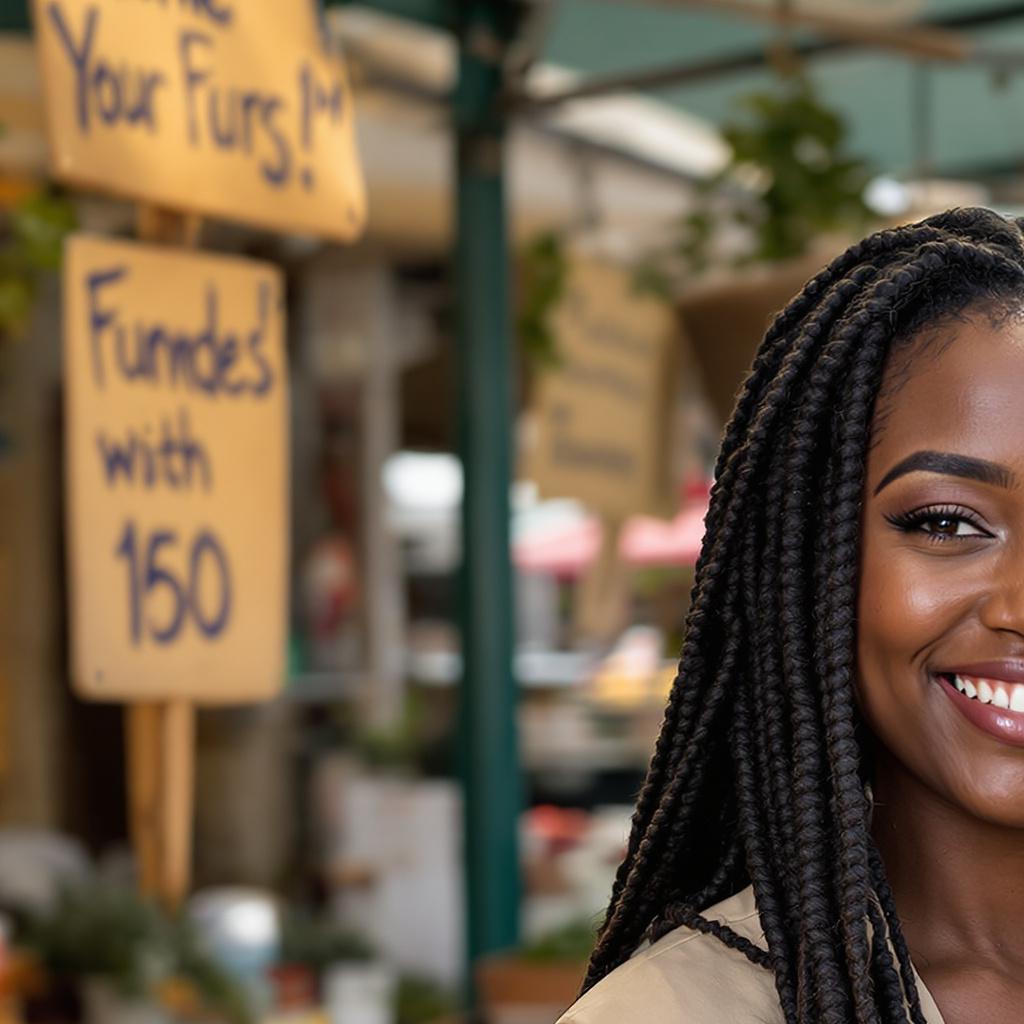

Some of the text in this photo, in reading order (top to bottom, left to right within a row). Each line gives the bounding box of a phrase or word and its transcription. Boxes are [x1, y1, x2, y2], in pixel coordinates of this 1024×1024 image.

[47, 2, 166, 137] Your
[96, 406, 214, 491] with
[114, 517, 233, 648] 150
